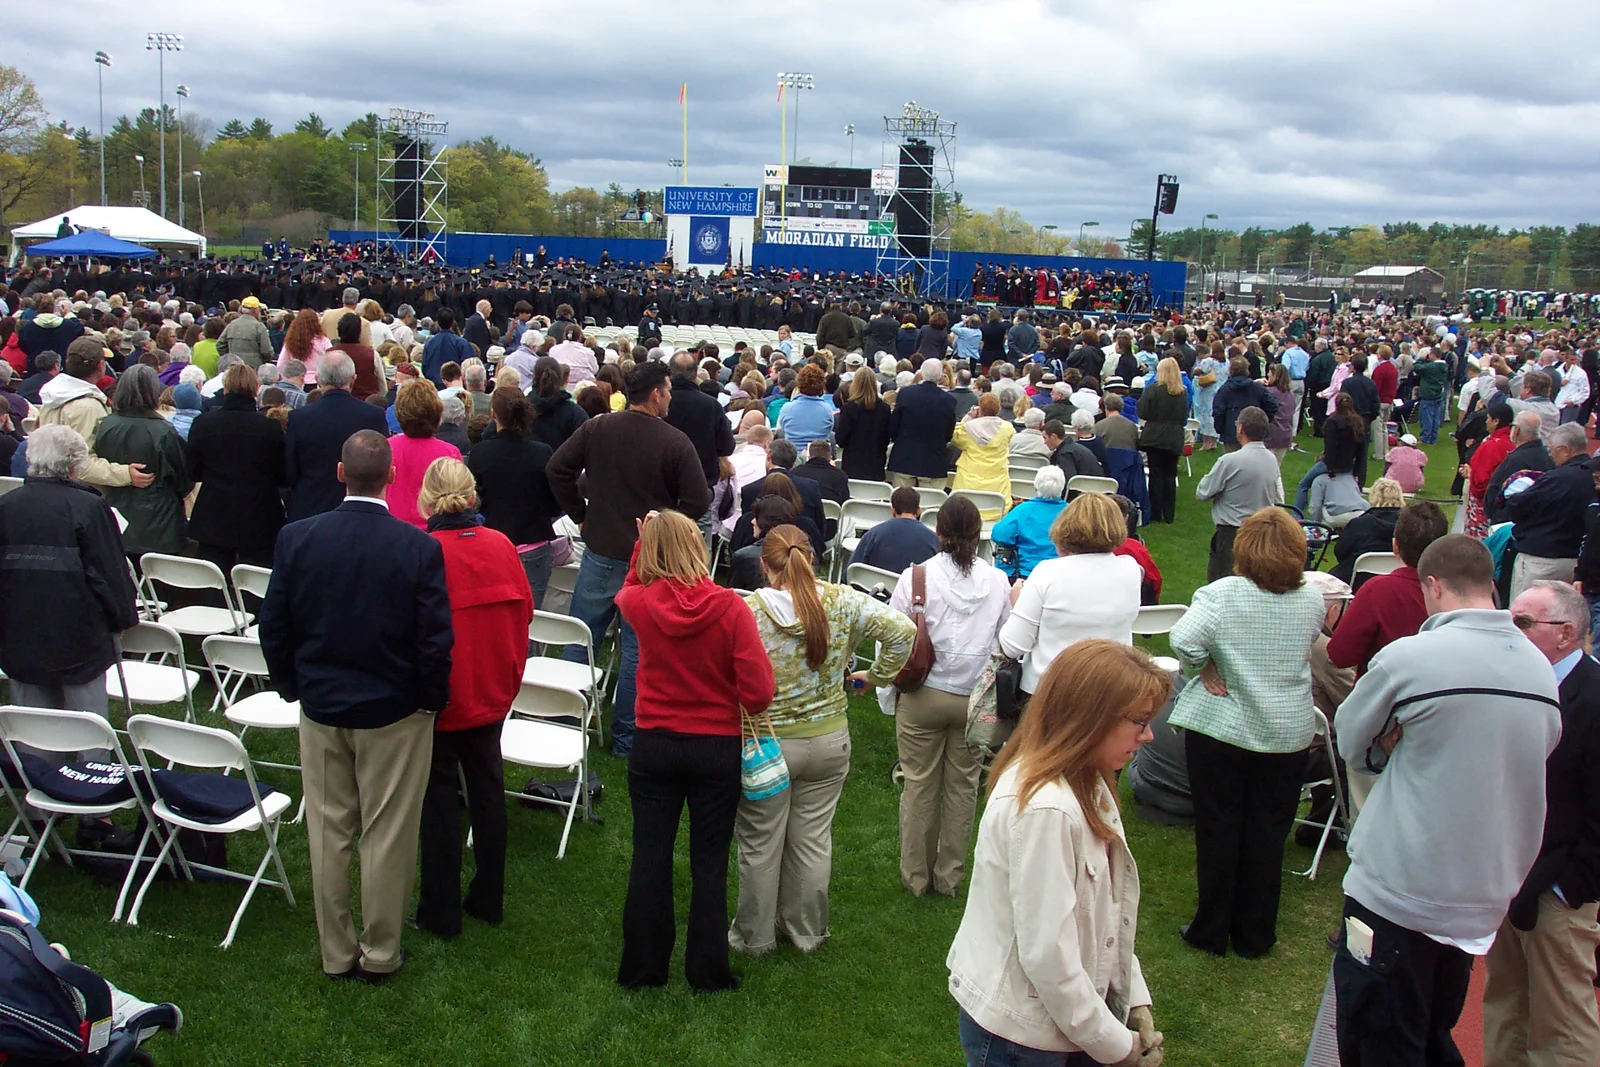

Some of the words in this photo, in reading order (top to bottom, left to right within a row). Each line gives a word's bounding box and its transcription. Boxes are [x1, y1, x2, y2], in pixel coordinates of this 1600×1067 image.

[669, 191, 733, 201] UNIVERSITY
[739, 192, 754, 202] OF
[668, 201, 692, 210] NEW
[697, 202, 753, 212] HAMPSHIRE
[765, 231, 845, 246] MOORADIAN
[849, 235, 889, 248] FIELD
[58, 765, 91, 781] NEW
